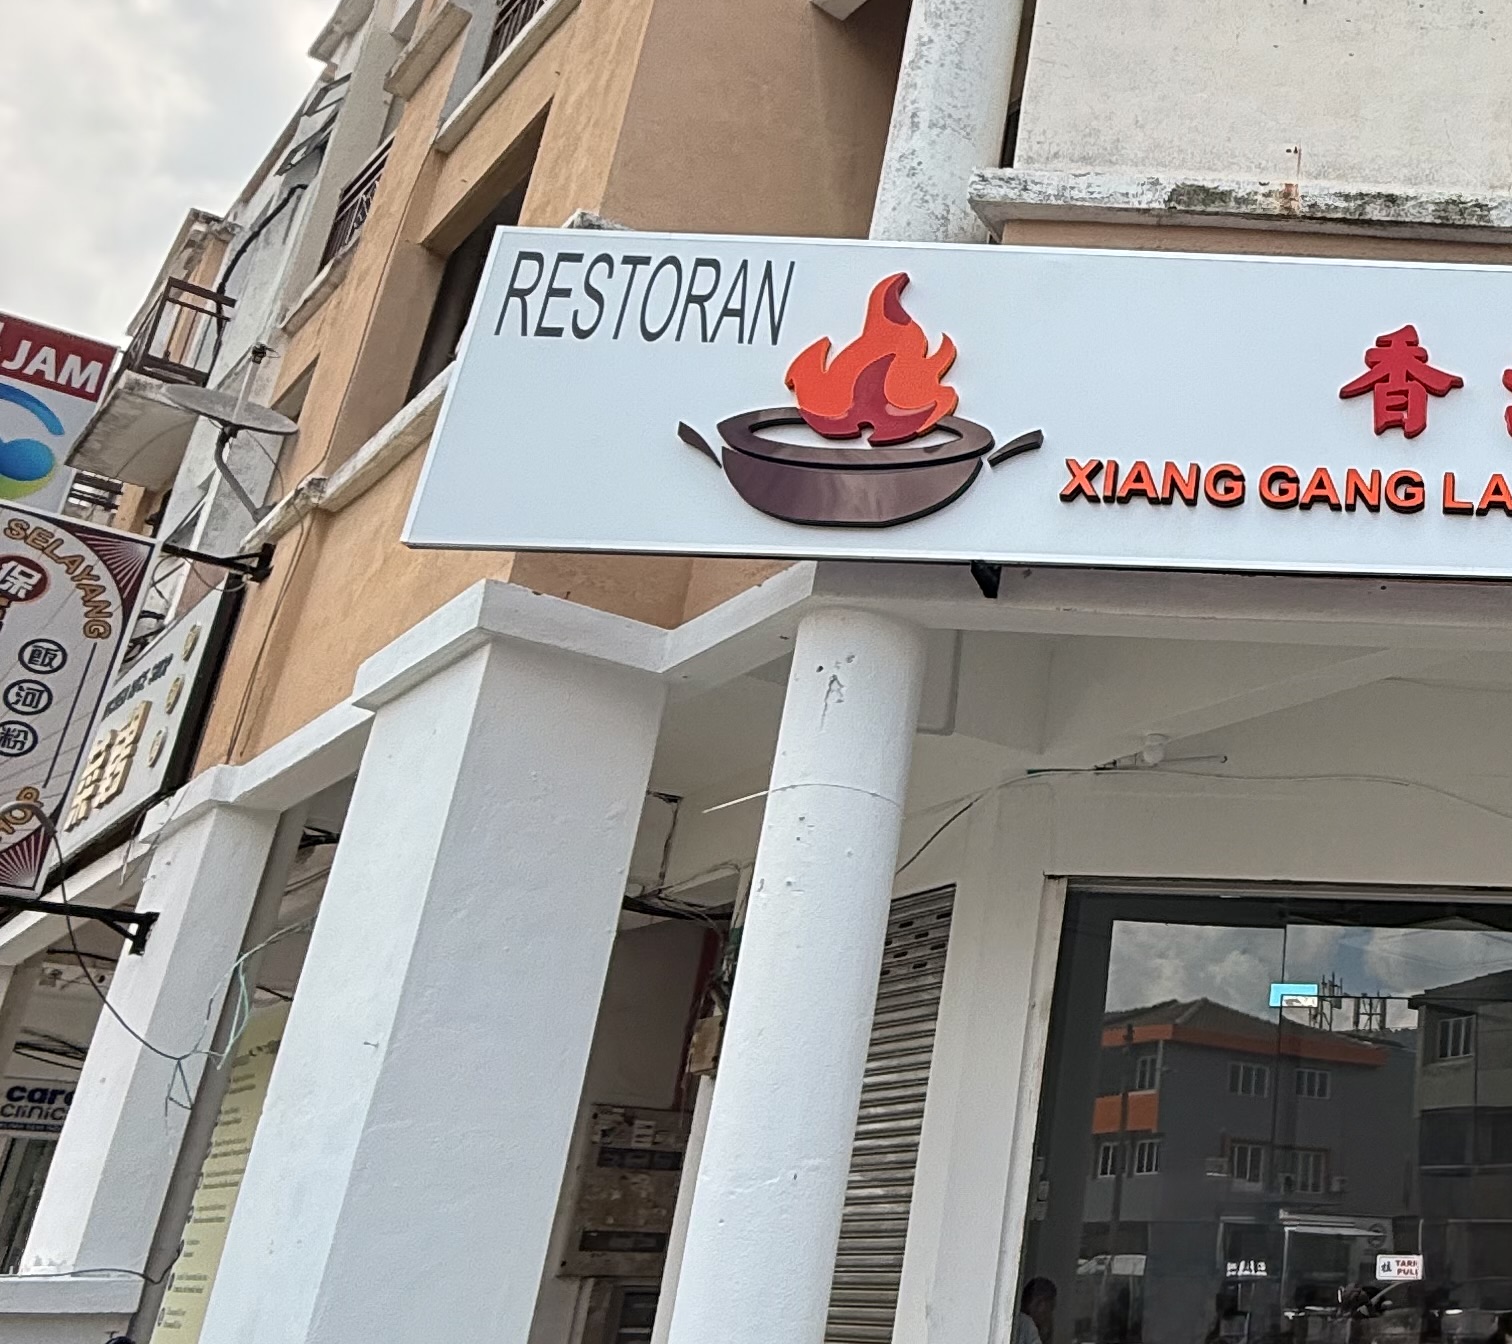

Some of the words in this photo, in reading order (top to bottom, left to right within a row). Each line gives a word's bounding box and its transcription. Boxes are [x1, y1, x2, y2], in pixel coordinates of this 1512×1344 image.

[494, 250, 796, 346] RESTORAN
[1, 339, 103, 394] JAM
[1059, 457, 1245, 508] XIANG
[1258, 463, 1426, 514] GANG
[3, 517, 113, 640] SELAYANG
[1395, 1259, 1418, 1267] TARI
